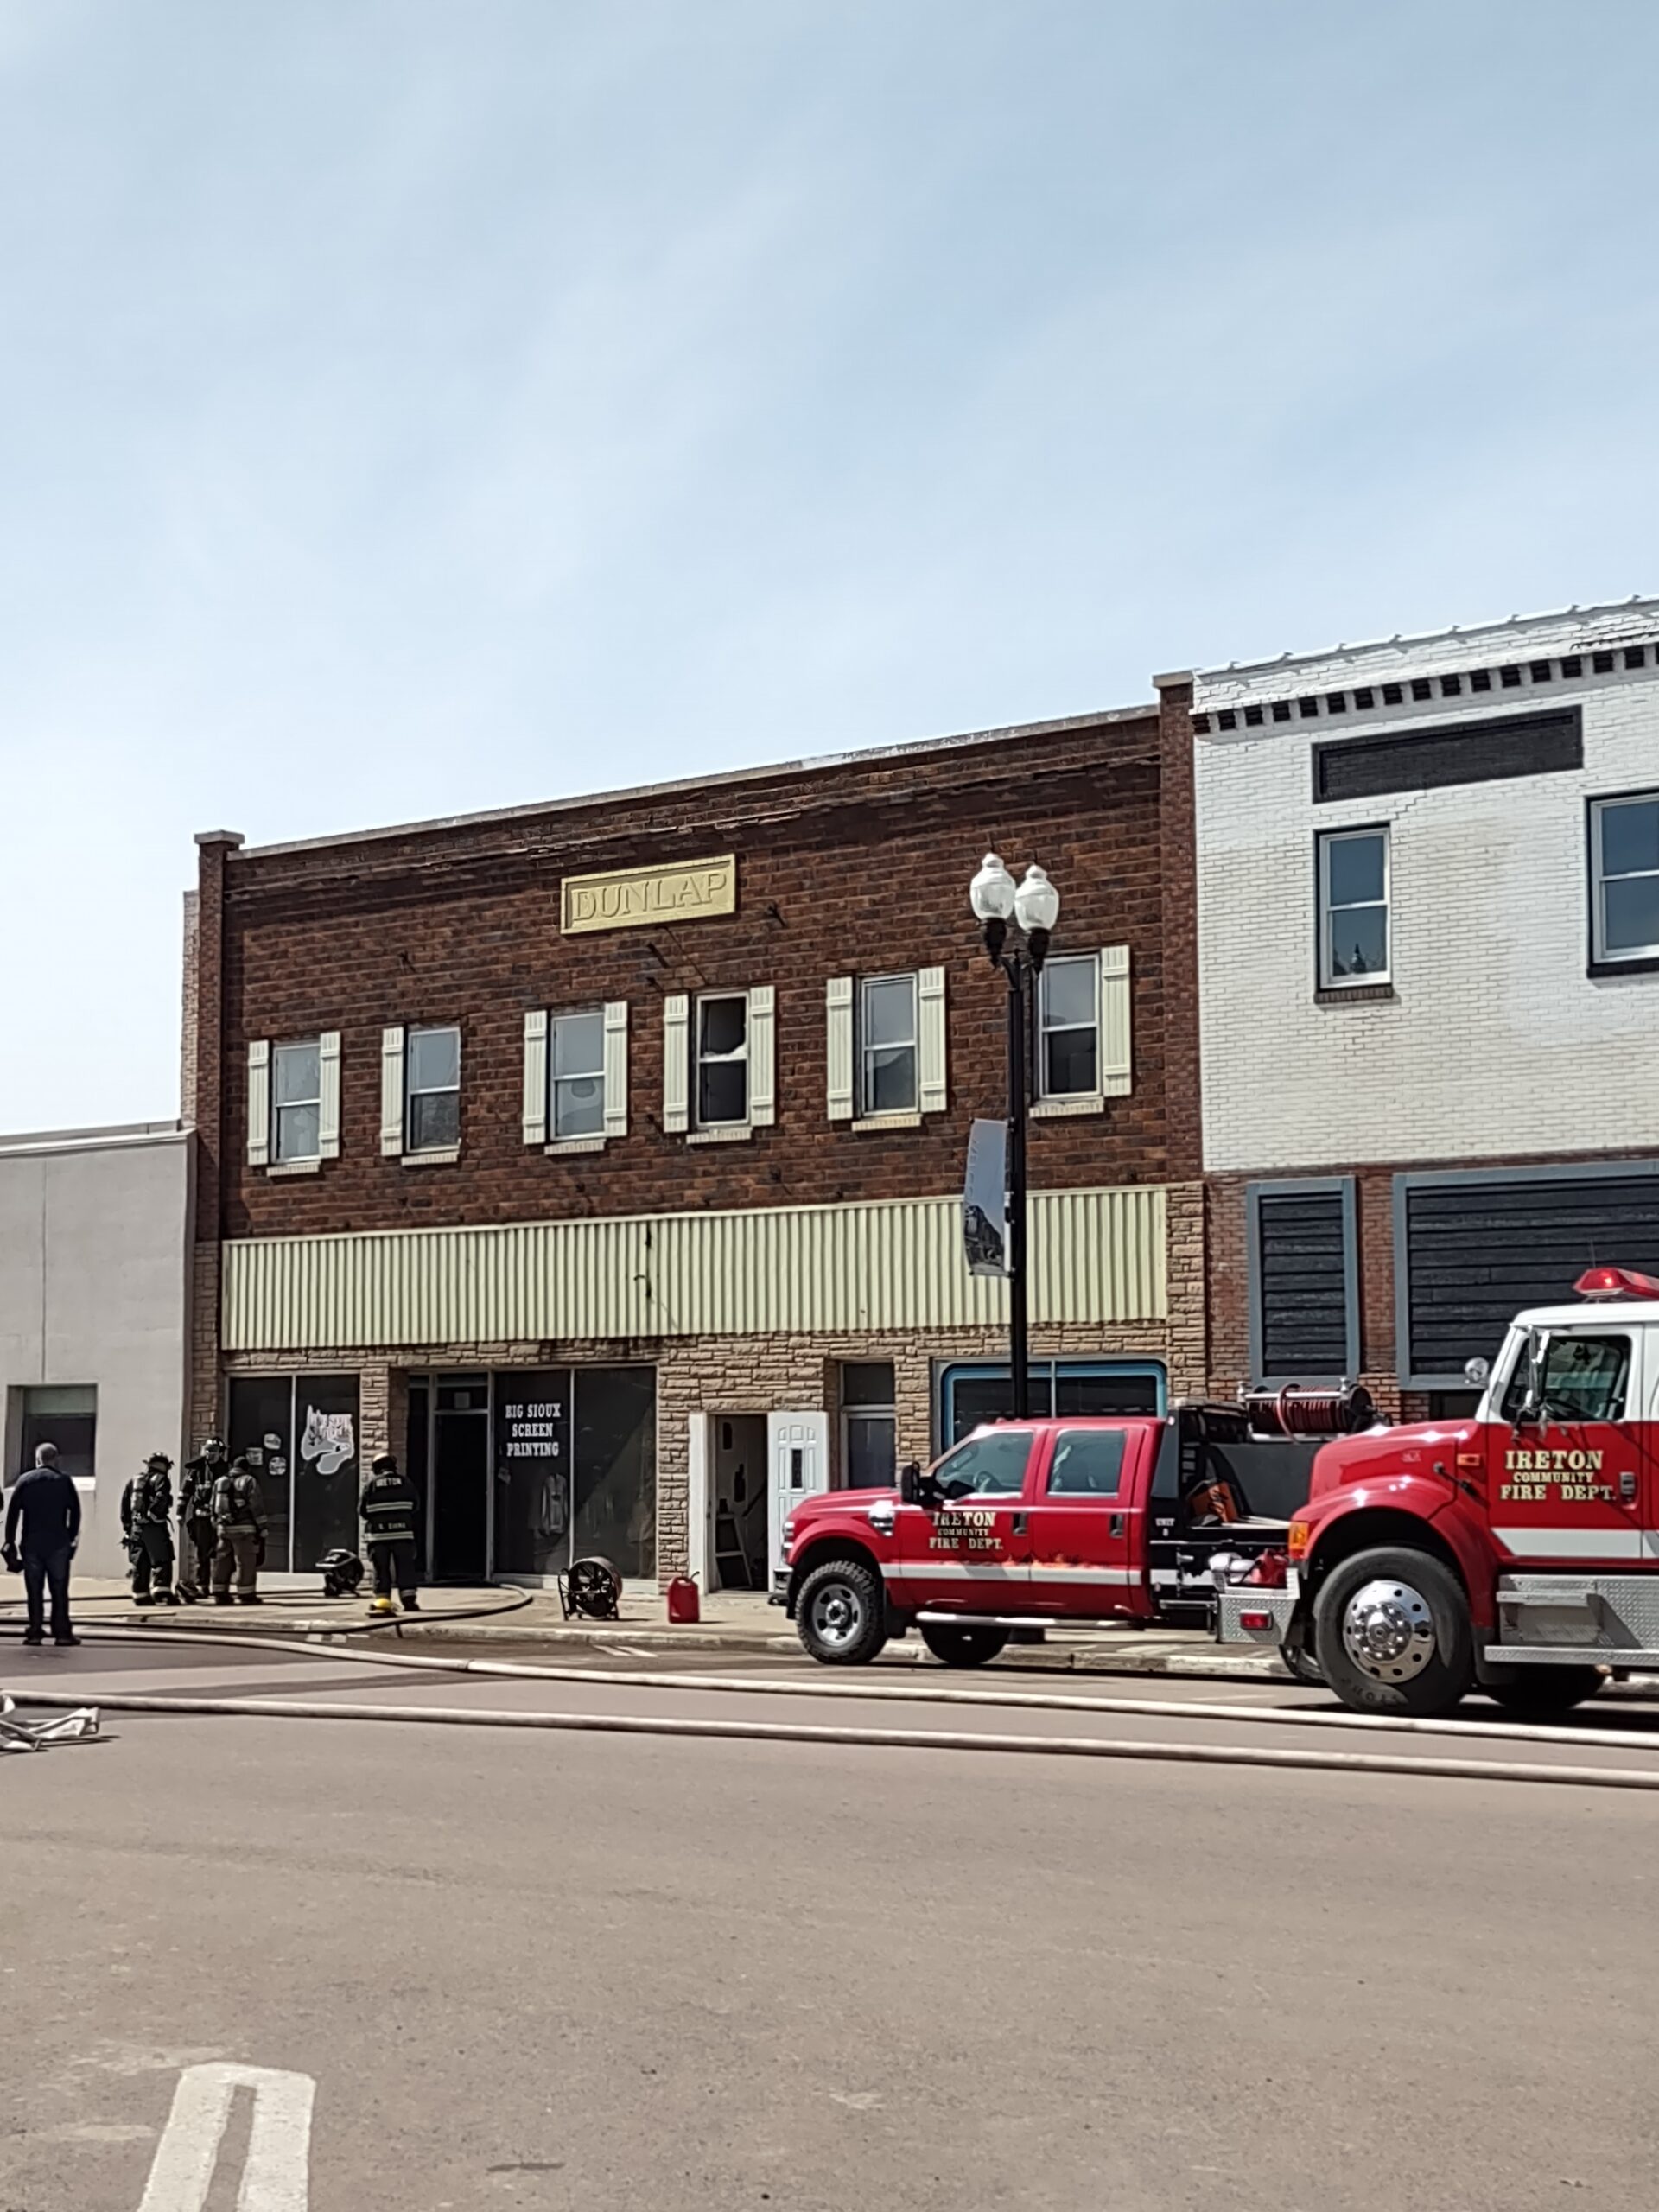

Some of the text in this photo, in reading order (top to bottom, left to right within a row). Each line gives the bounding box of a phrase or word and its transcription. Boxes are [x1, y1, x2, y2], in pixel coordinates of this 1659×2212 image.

[573, 873, 727, 921] DUNLAP
[505, 1403, 562, 1419] BIG SIOUX
[512, 1423, 554, 1438] SCREEN
[506, 1441, 559, 1457] PRINTING
[1505, 1450, 1604, 1470] IRETON
[1513, 1471, 1595, 1483] COMMUNITY
[1500, 1484, 1617, 1500] FIRE DEPT.
[932, 1511, 996, 1527] IRETON
[938, 1528, 989, 1536] COMMUNITY
[929, 1537, 1004, 1549] FIRE DEPT.
